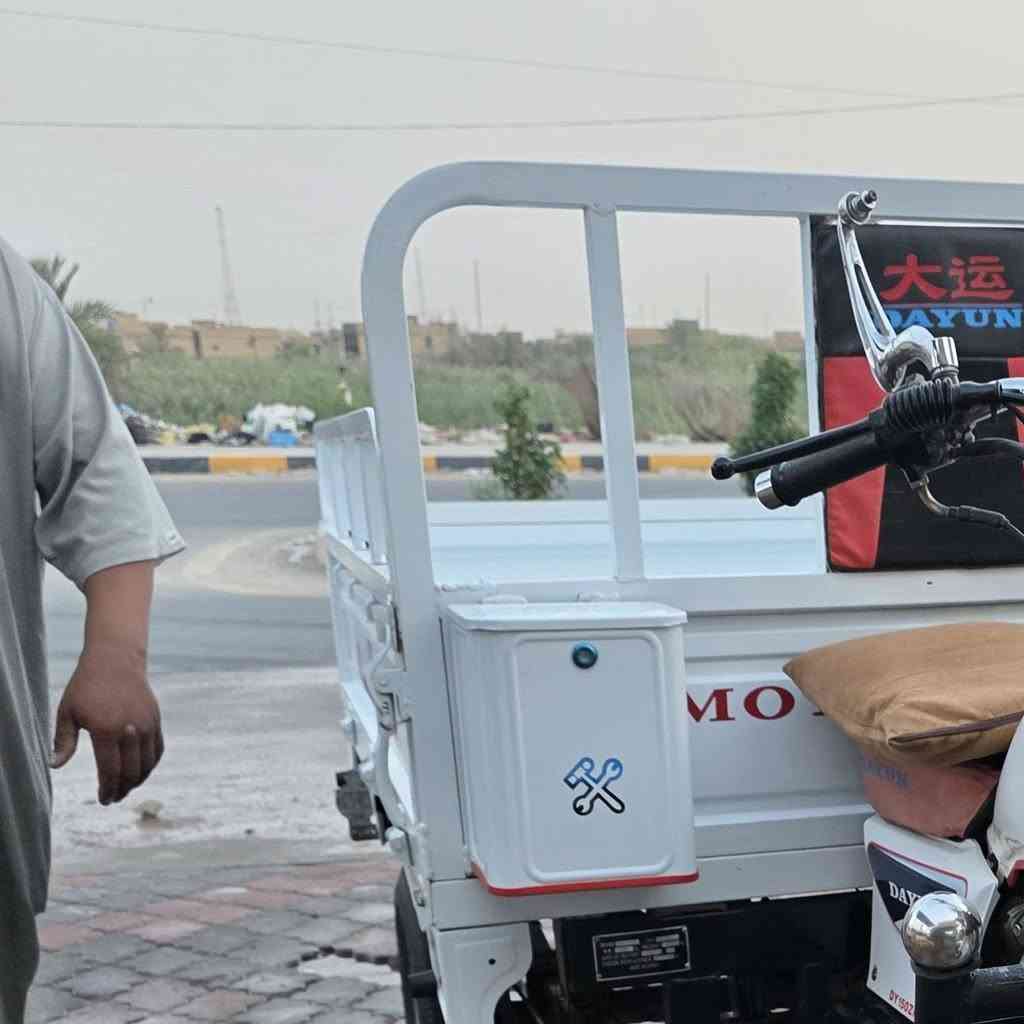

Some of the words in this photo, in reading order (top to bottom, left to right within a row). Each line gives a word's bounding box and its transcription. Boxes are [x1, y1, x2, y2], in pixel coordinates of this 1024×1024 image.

[879, 253, 1015, 301] 大运
[884, 307, 1023, 328] DAYUN
[686, 685, 825, 723] MO
[888, 880, 921, 907] DAY
